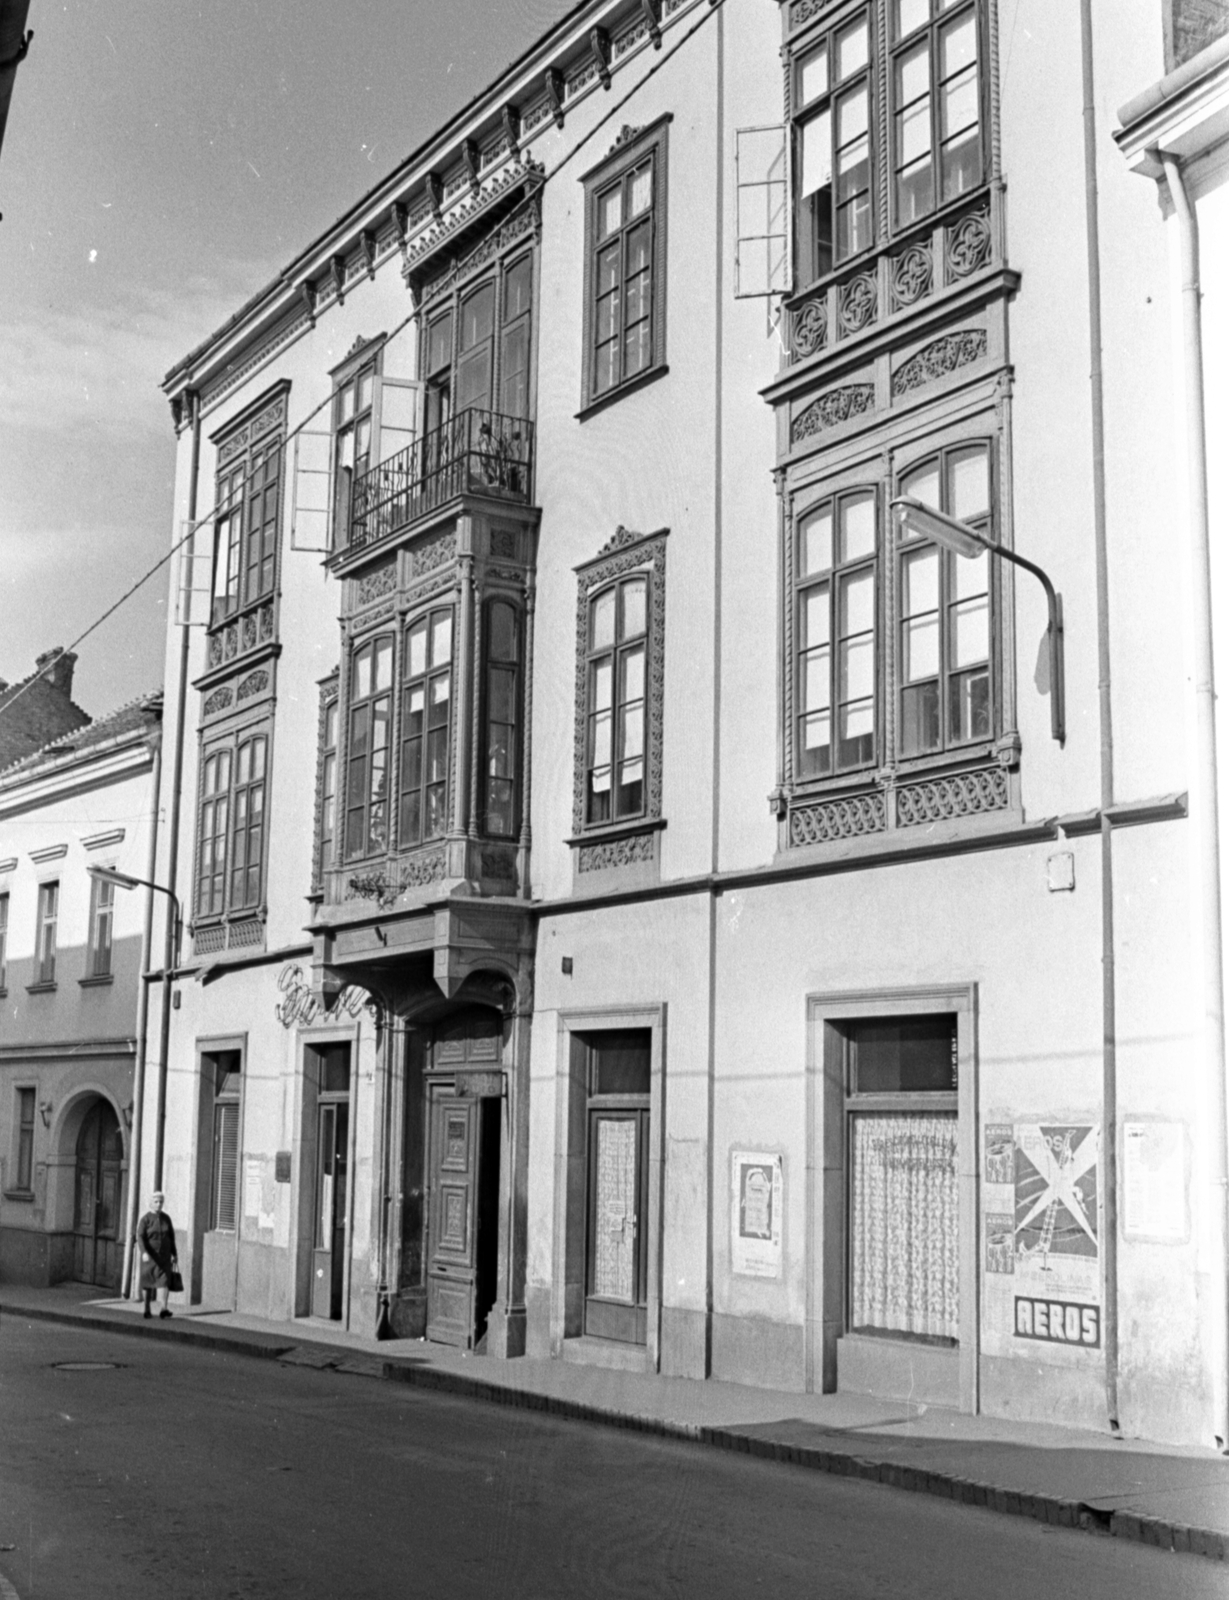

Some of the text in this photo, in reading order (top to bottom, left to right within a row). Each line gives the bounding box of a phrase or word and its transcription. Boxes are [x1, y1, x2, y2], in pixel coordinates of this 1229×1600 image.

[986, 1128, 1012, 1136] AEROS
[987, 1217, 1013, 1226] AEROS
[1017, 1300, 1097, 1343] AEROS
